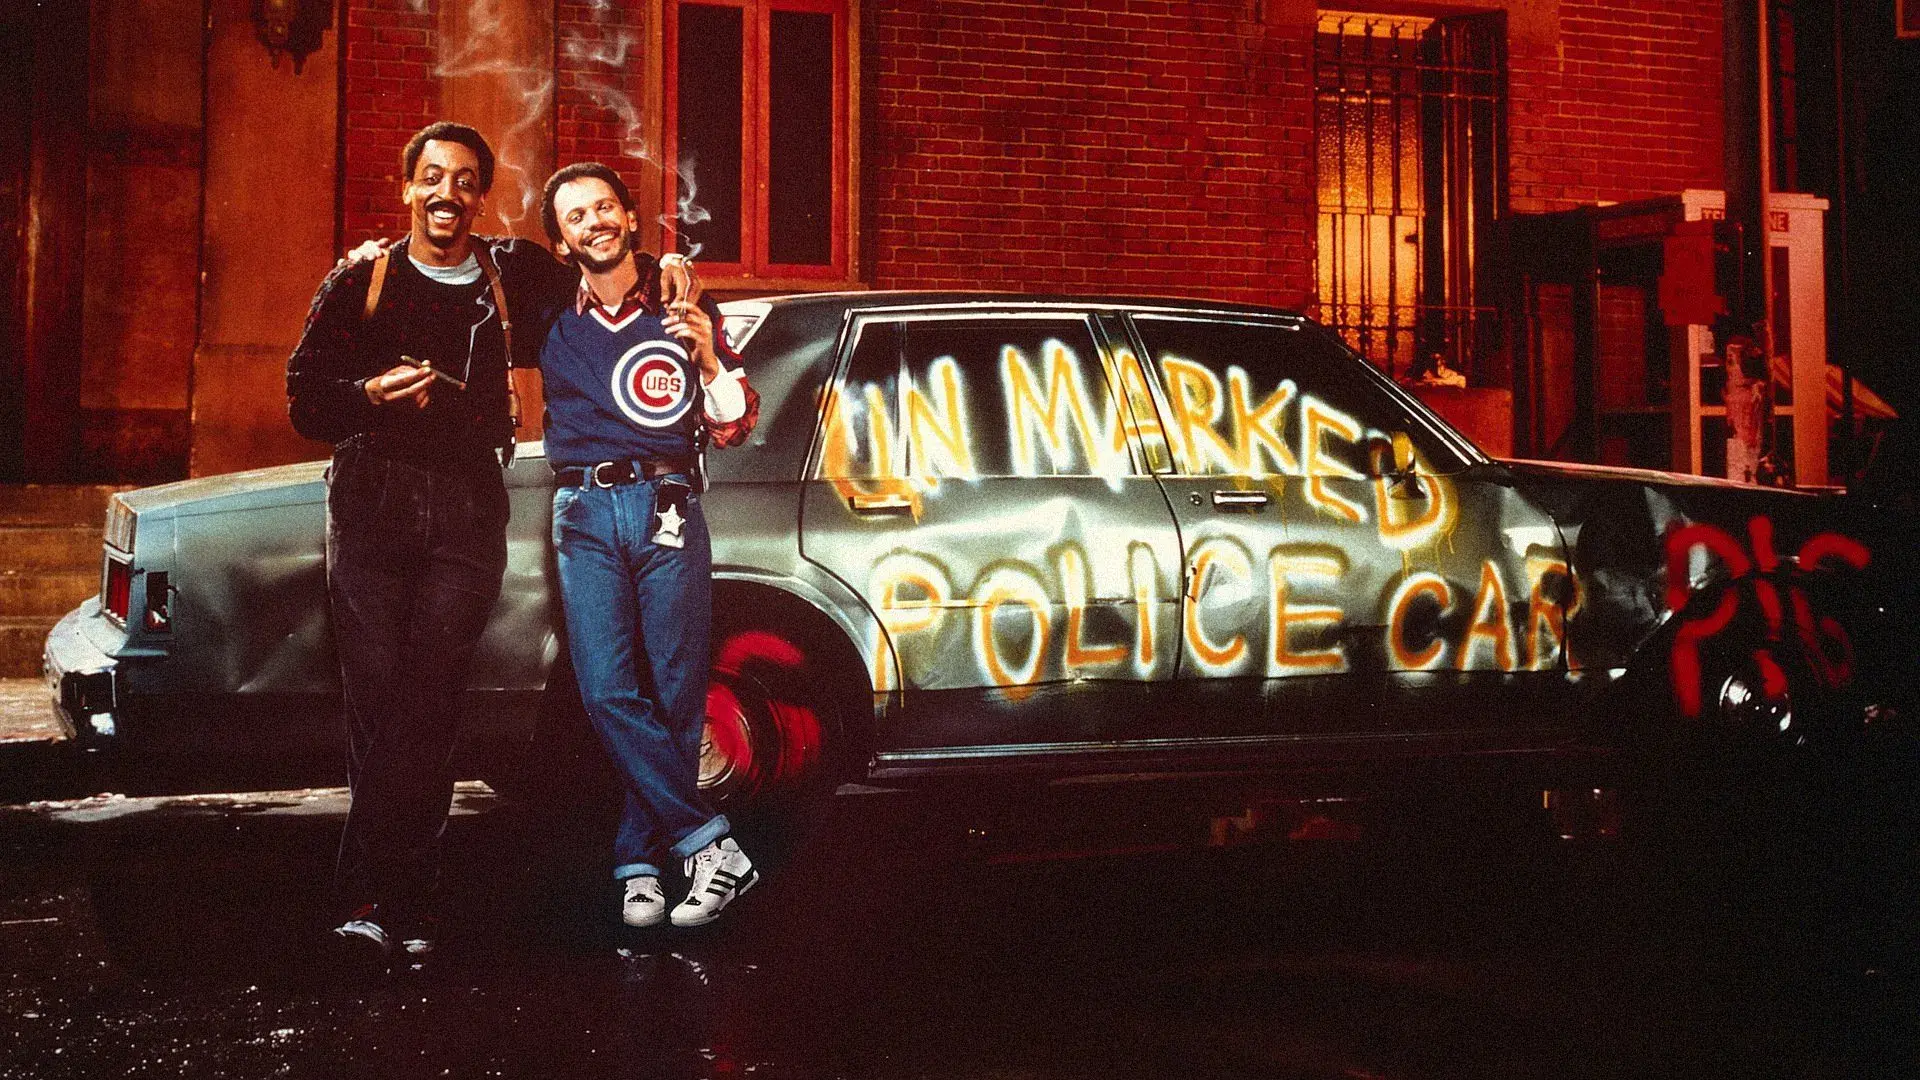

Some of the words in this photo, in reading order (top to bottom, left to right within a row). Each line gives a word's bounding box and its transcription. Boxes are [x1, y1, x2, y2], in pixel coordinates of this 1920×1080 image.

[633, 359, 682, 408] CUBS
[819, 360, 977, 512] UN
[1003, 340, 1454, 544] MARKED
[872, 537, 1347, 699] POLICE
[1388, 555, 1585, 677] CAR
